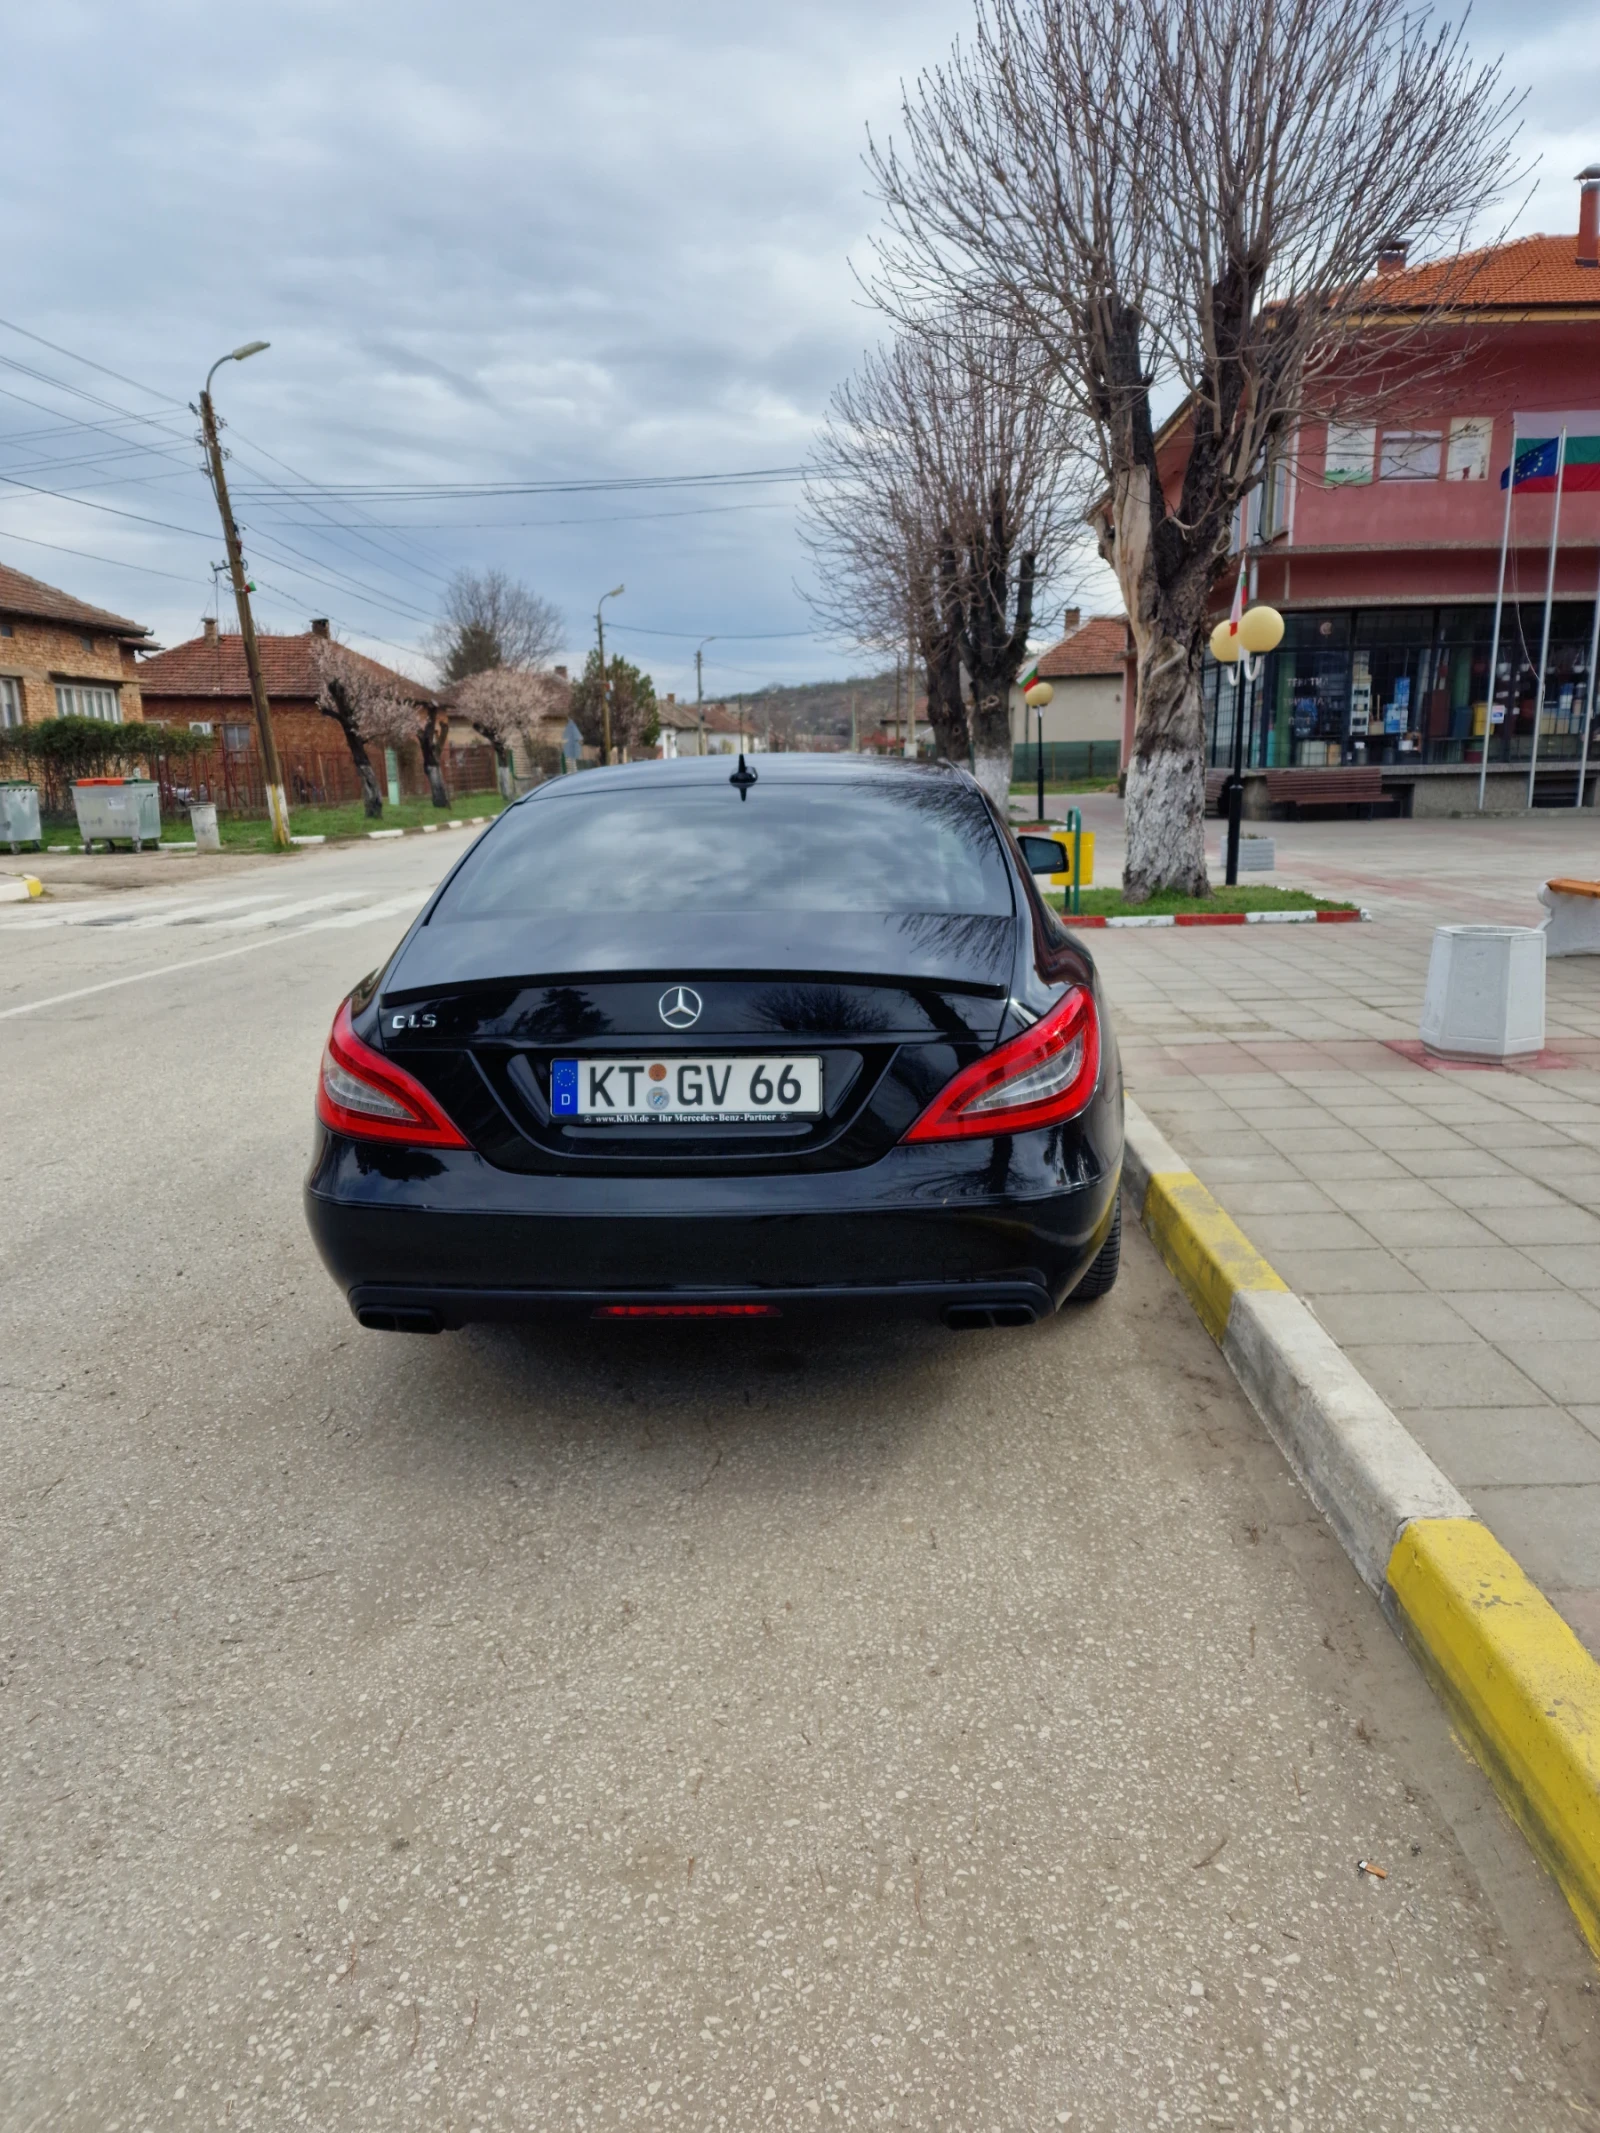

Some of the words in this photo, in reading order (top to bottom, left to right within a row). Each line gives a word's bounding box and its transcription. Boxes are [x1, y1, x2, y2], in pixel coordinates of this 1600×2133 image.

[392, 1014, 437, 1029] CLS
[589, 1065, 645, 1108] KT
[677, 1064, 732, 1106] GV
[749, 1064, 802, 1105] 66
[561, 1094, 570, 1106] D
[595, 1114, 650, 1123] www.KBM.de
[658, 1114, 673, 1122] Ihr
[675, 1113, 777, 1123] Mercedes-Benz-Partner
